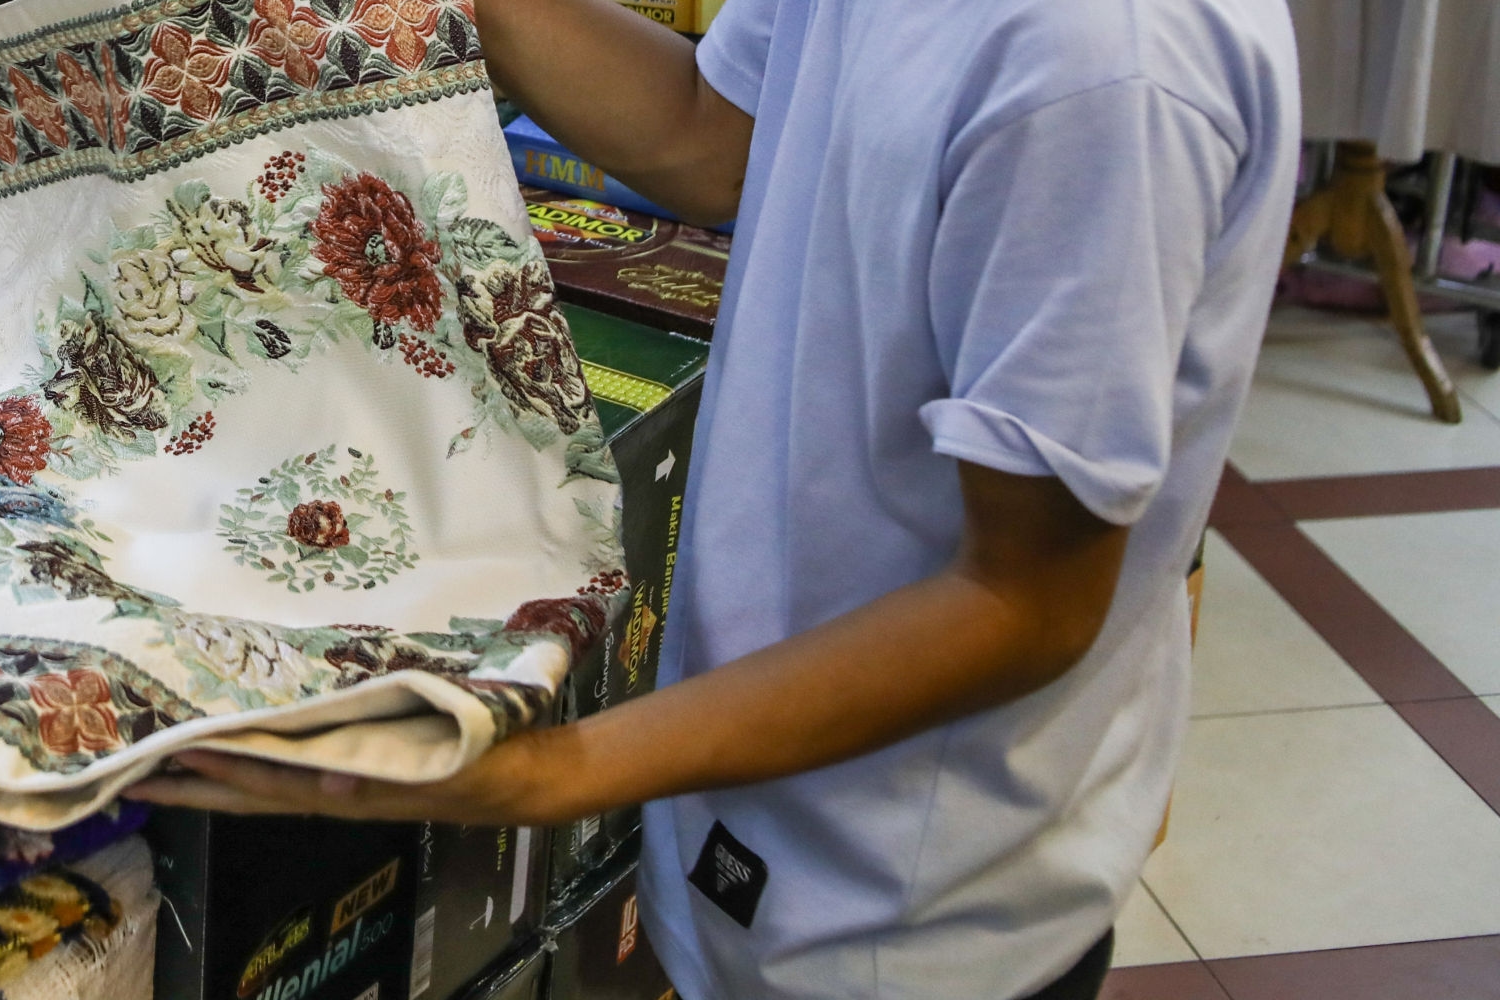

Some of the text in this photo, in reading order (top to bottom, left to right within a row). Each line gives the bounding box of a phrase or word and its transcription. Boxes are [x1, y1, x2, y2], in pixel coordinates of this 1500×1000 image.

[524, 149, 606, 192] HMM
[667, 495, 682, 548] Makin
[628, 584, 645, 686] WADIMOR
[594, 631, 615, 698] Sarung
[339, 871, 392, 925] NEW
[360, 912, 394, 951] 500
